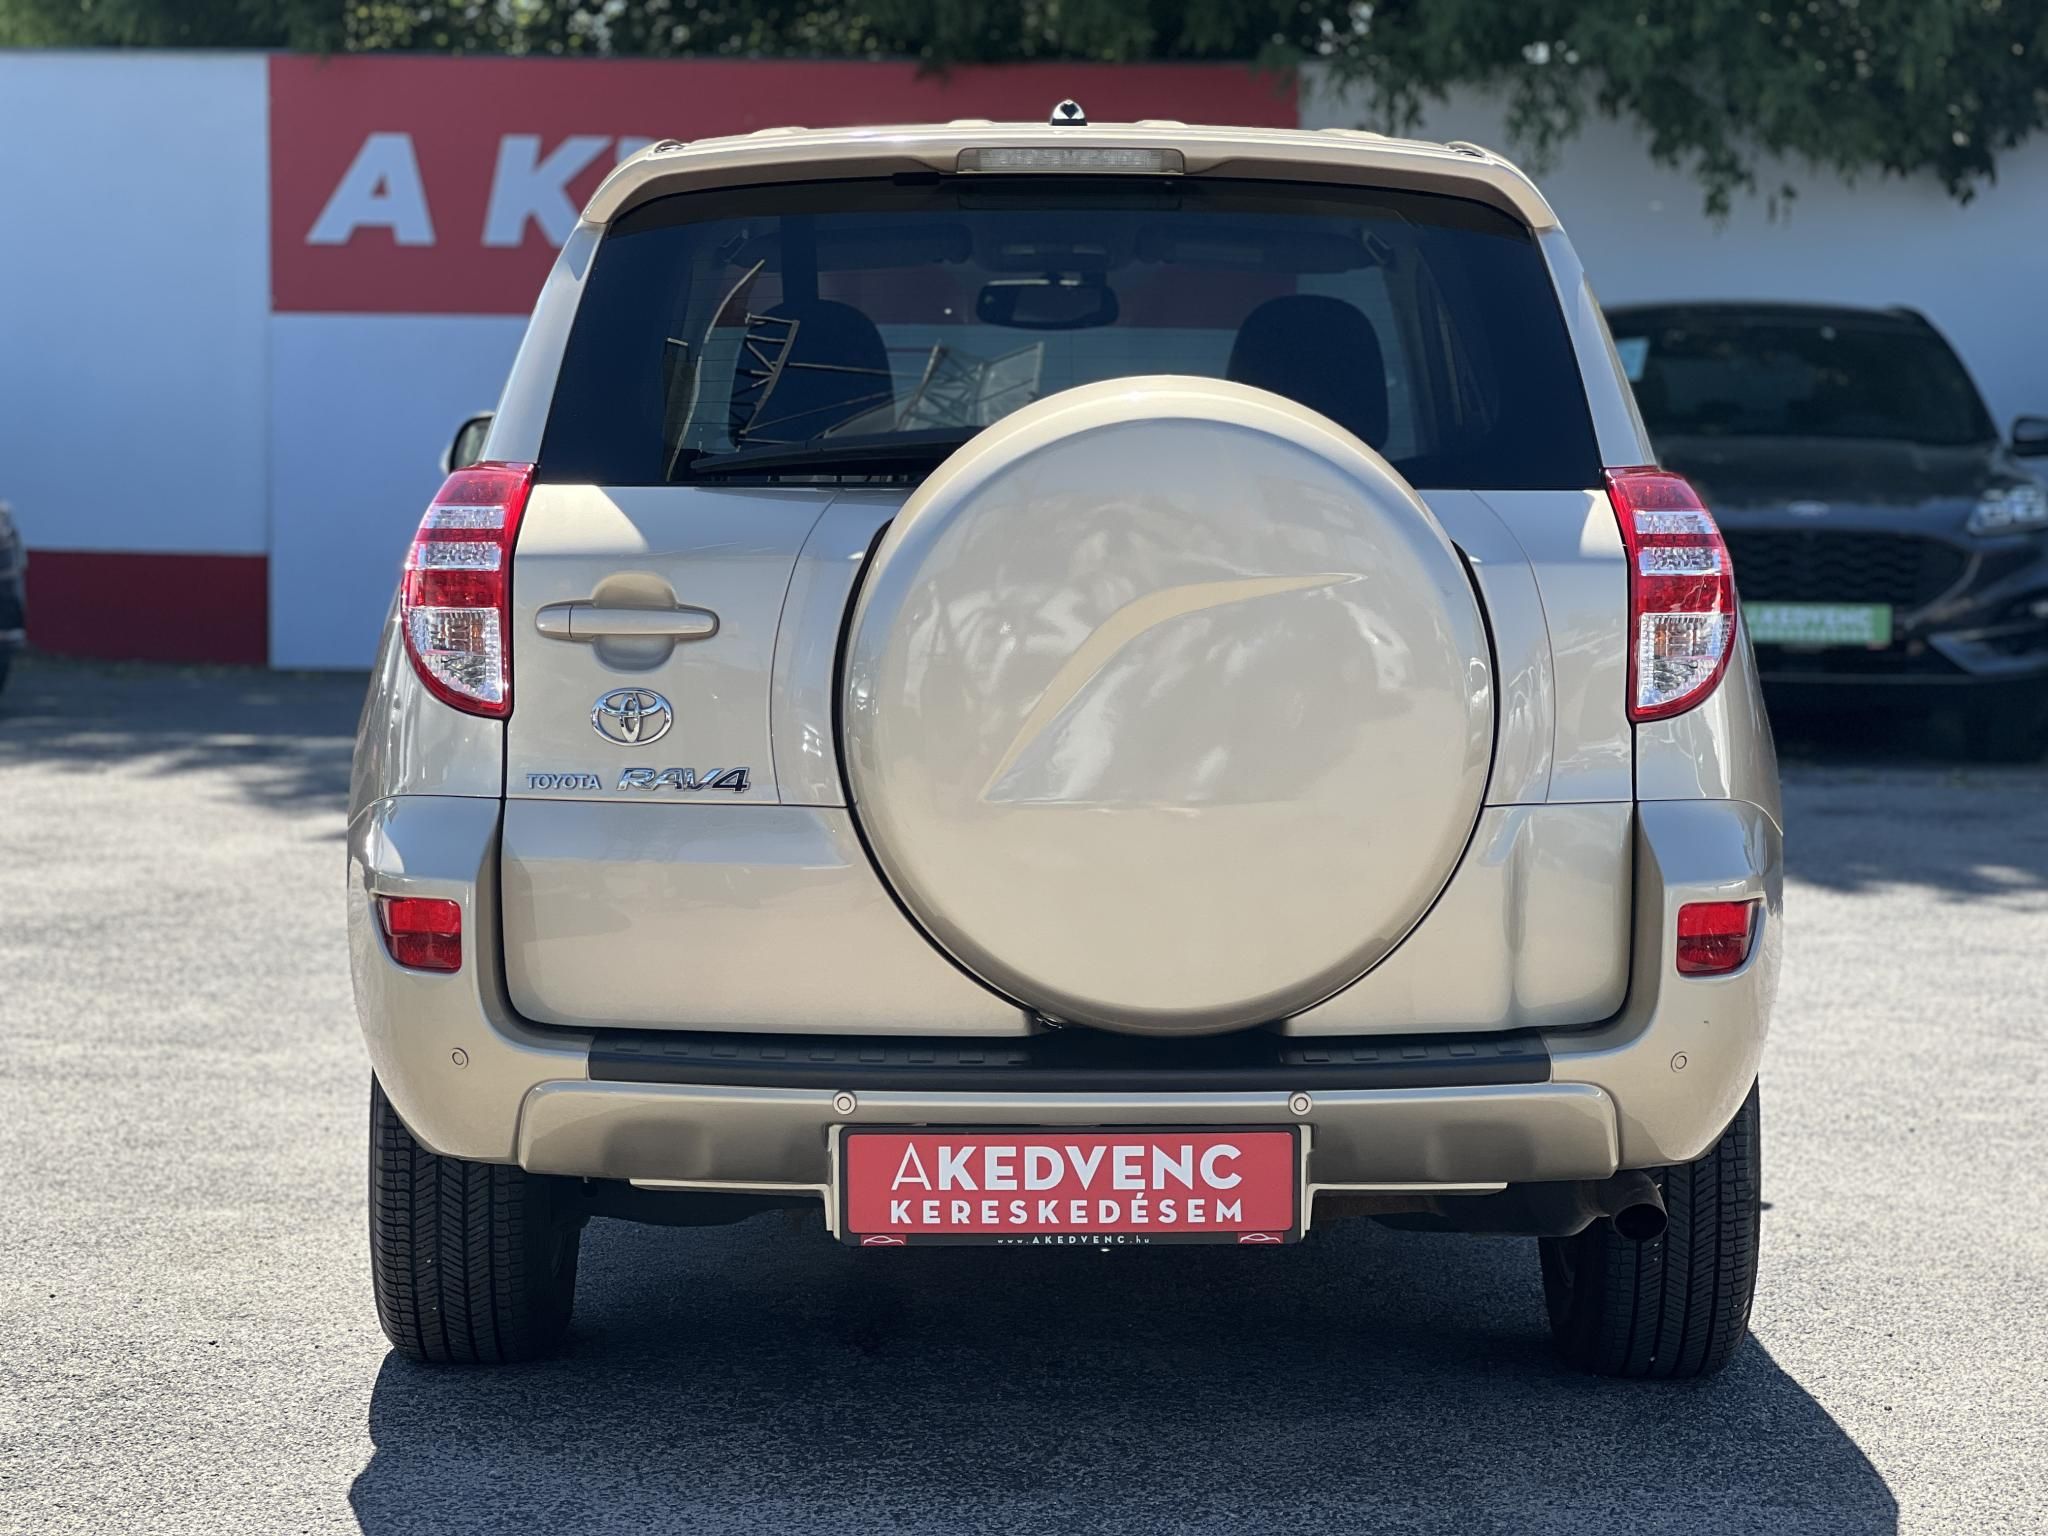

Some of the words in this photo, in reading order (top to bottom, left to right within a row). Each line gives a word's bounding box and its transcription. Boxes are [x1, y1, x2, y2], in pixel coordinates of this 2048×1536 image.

[305, 131, 436, 247] A
[526, 773, 603, 791] TOYOTA
[616, 767, 751, 793] RAV4
[891, 1143, 1242, 1191] AKEDVENC
[890, 1192, 1242, 1225] KERESKEDÉSEM
